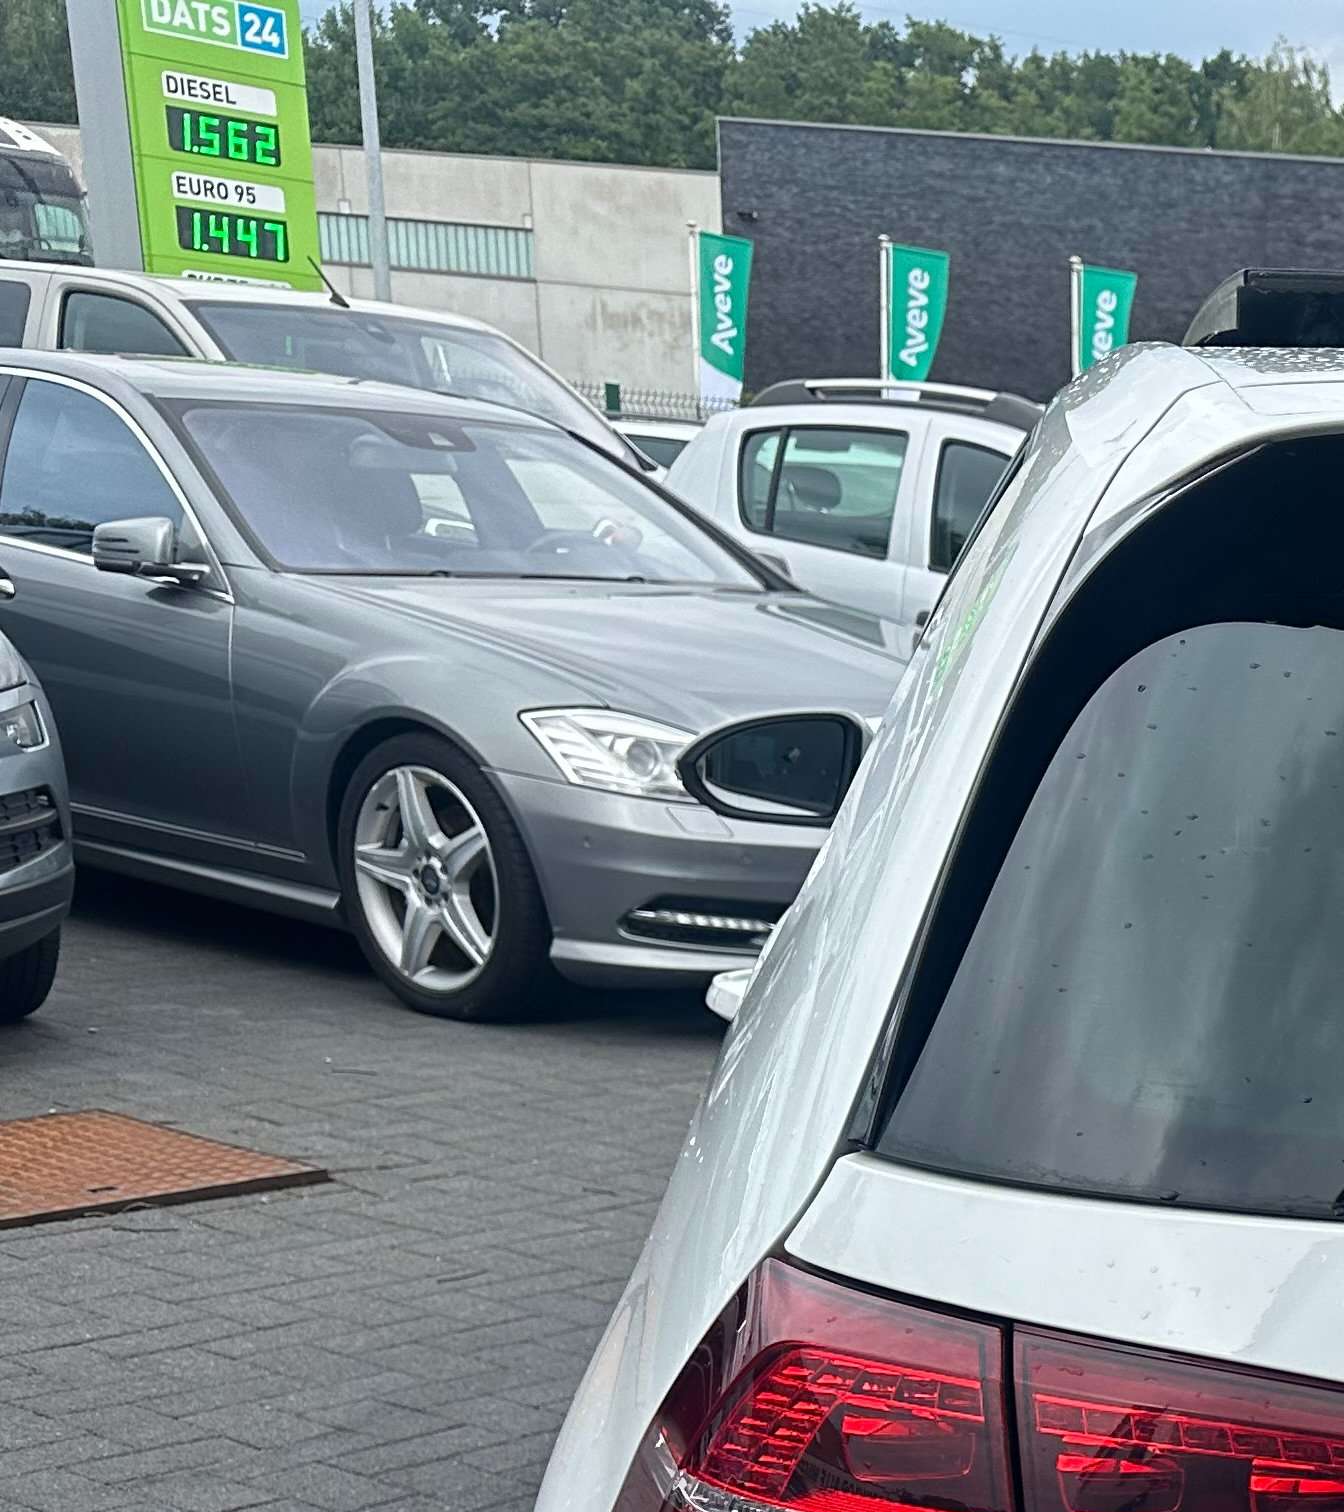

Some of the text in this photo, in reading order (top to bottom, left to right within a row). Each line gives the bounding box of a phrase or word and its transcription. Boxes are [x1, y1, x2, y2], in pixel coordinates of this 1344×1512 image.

[151, 0, 281, 48] DATS 24
[166, 75, 237, 105] DIESEL
[183, 112, 277, 165] 1.562
[176, 175, 256, 205] EURO 95
[193, 212, 285, 261] 1.447
[710, 254, 738, 355] Aveve
[899, 267, 931, 367] Aveve
